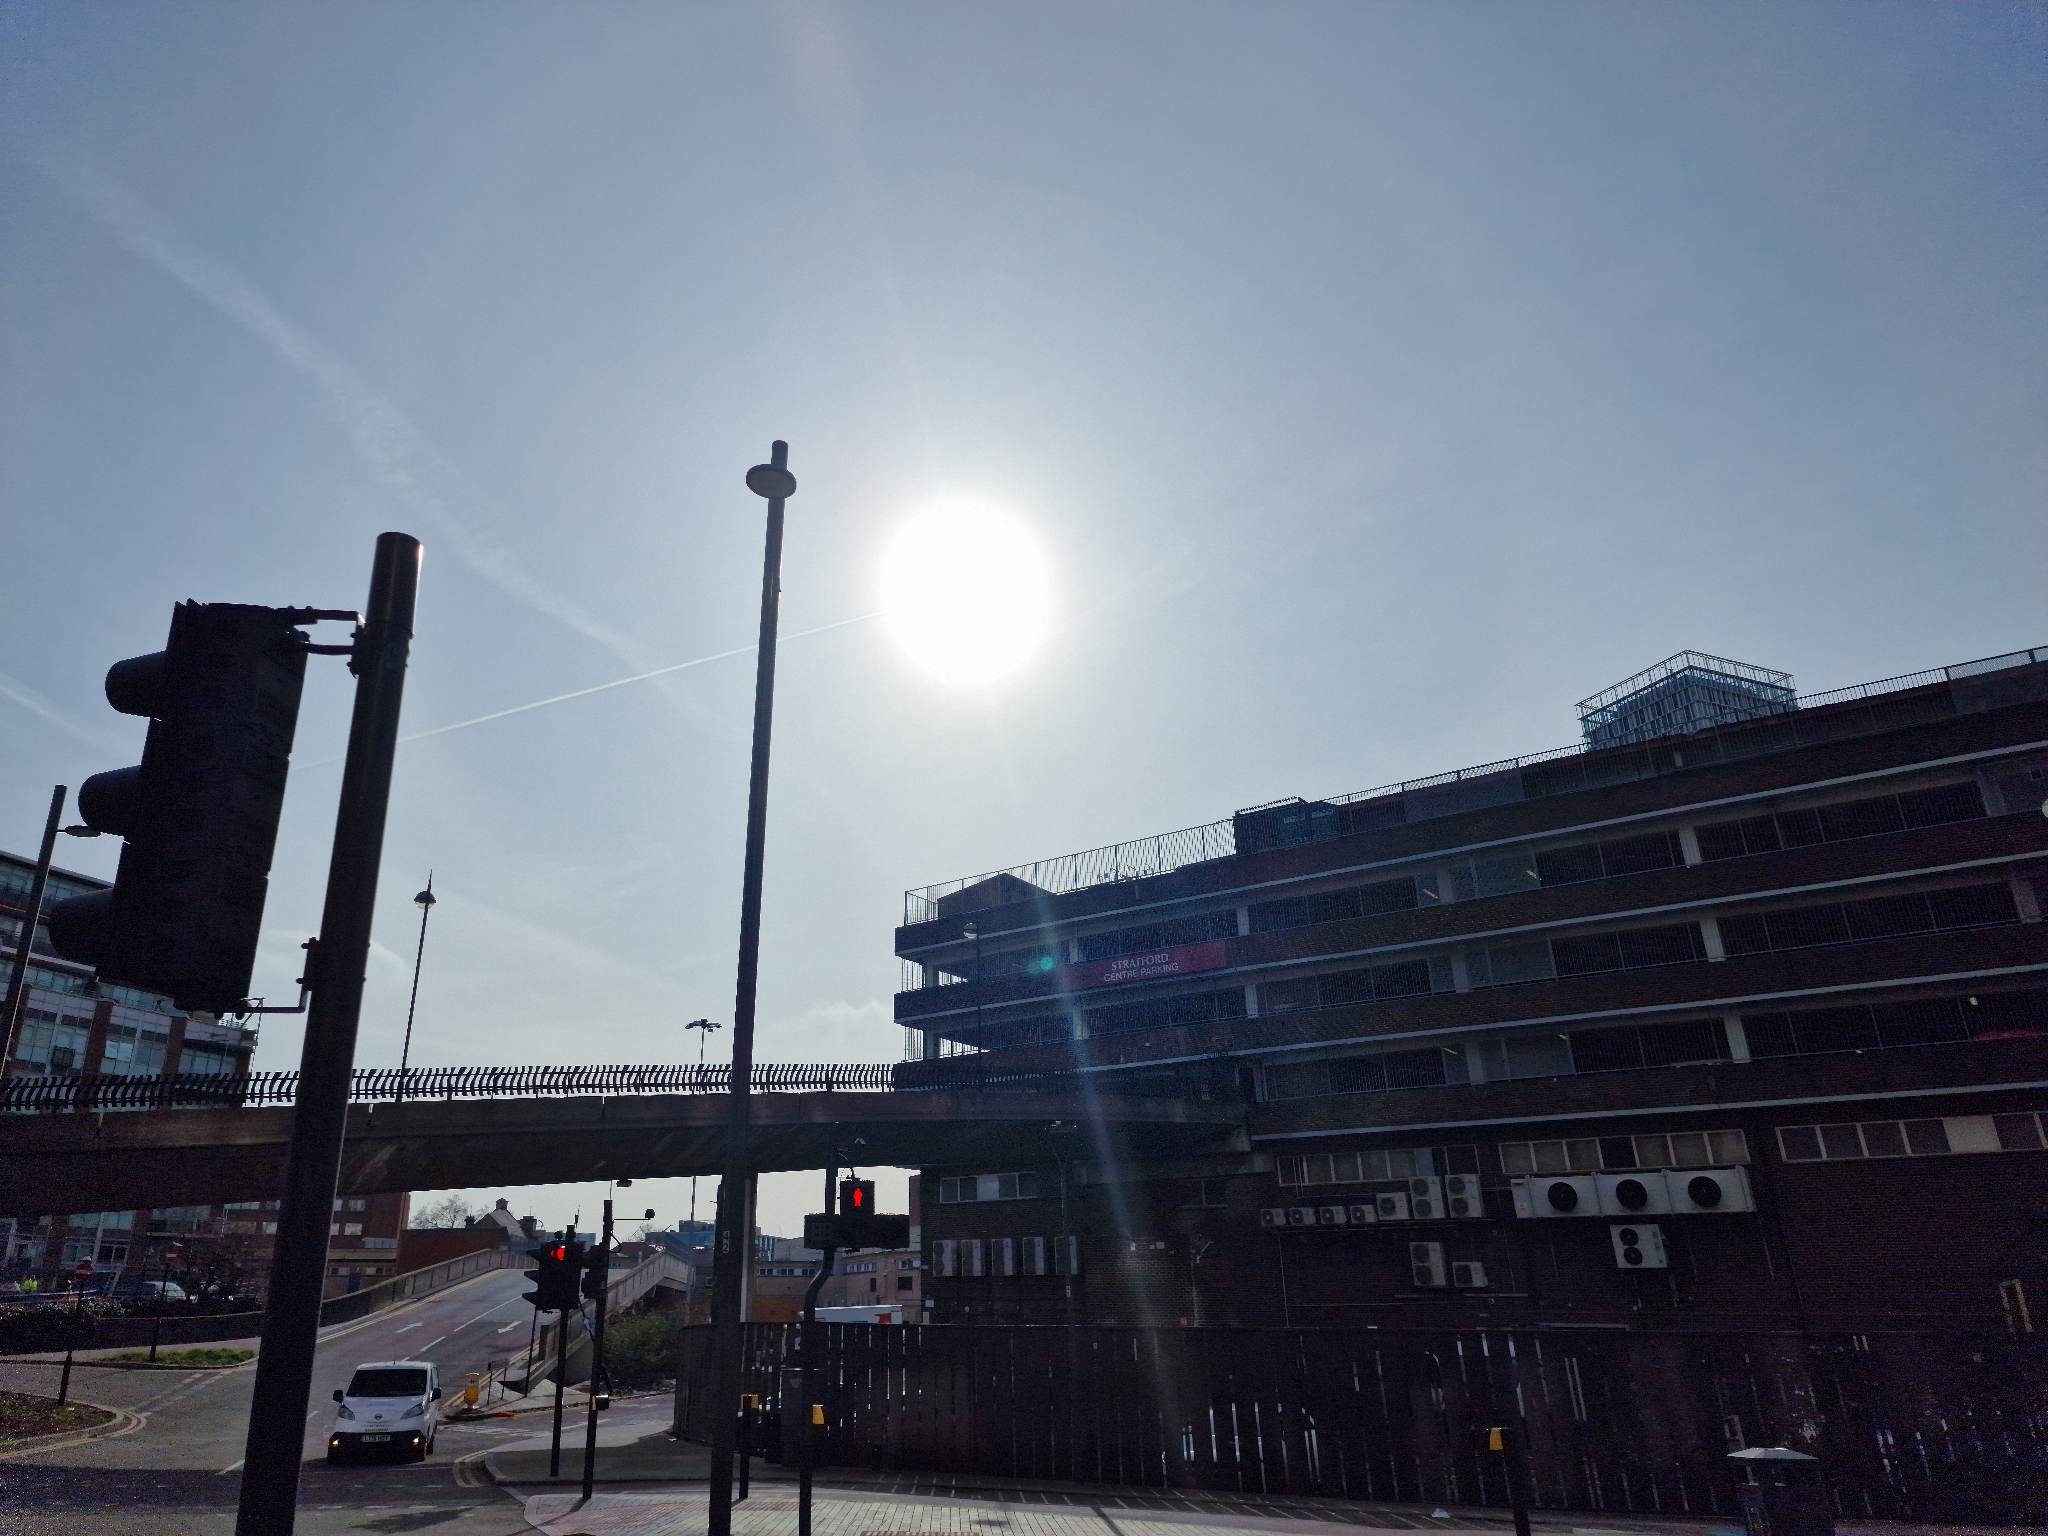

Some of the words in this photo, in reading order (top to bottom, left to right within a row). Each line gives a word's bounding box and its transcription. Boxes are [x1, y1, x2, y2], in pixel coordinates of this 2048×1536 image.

[1111, 953, 1169, 971] STRATFORD
[1103, 969, 1138, 982] CENTRE
[1140, 962, 1179, 976] PARKING
